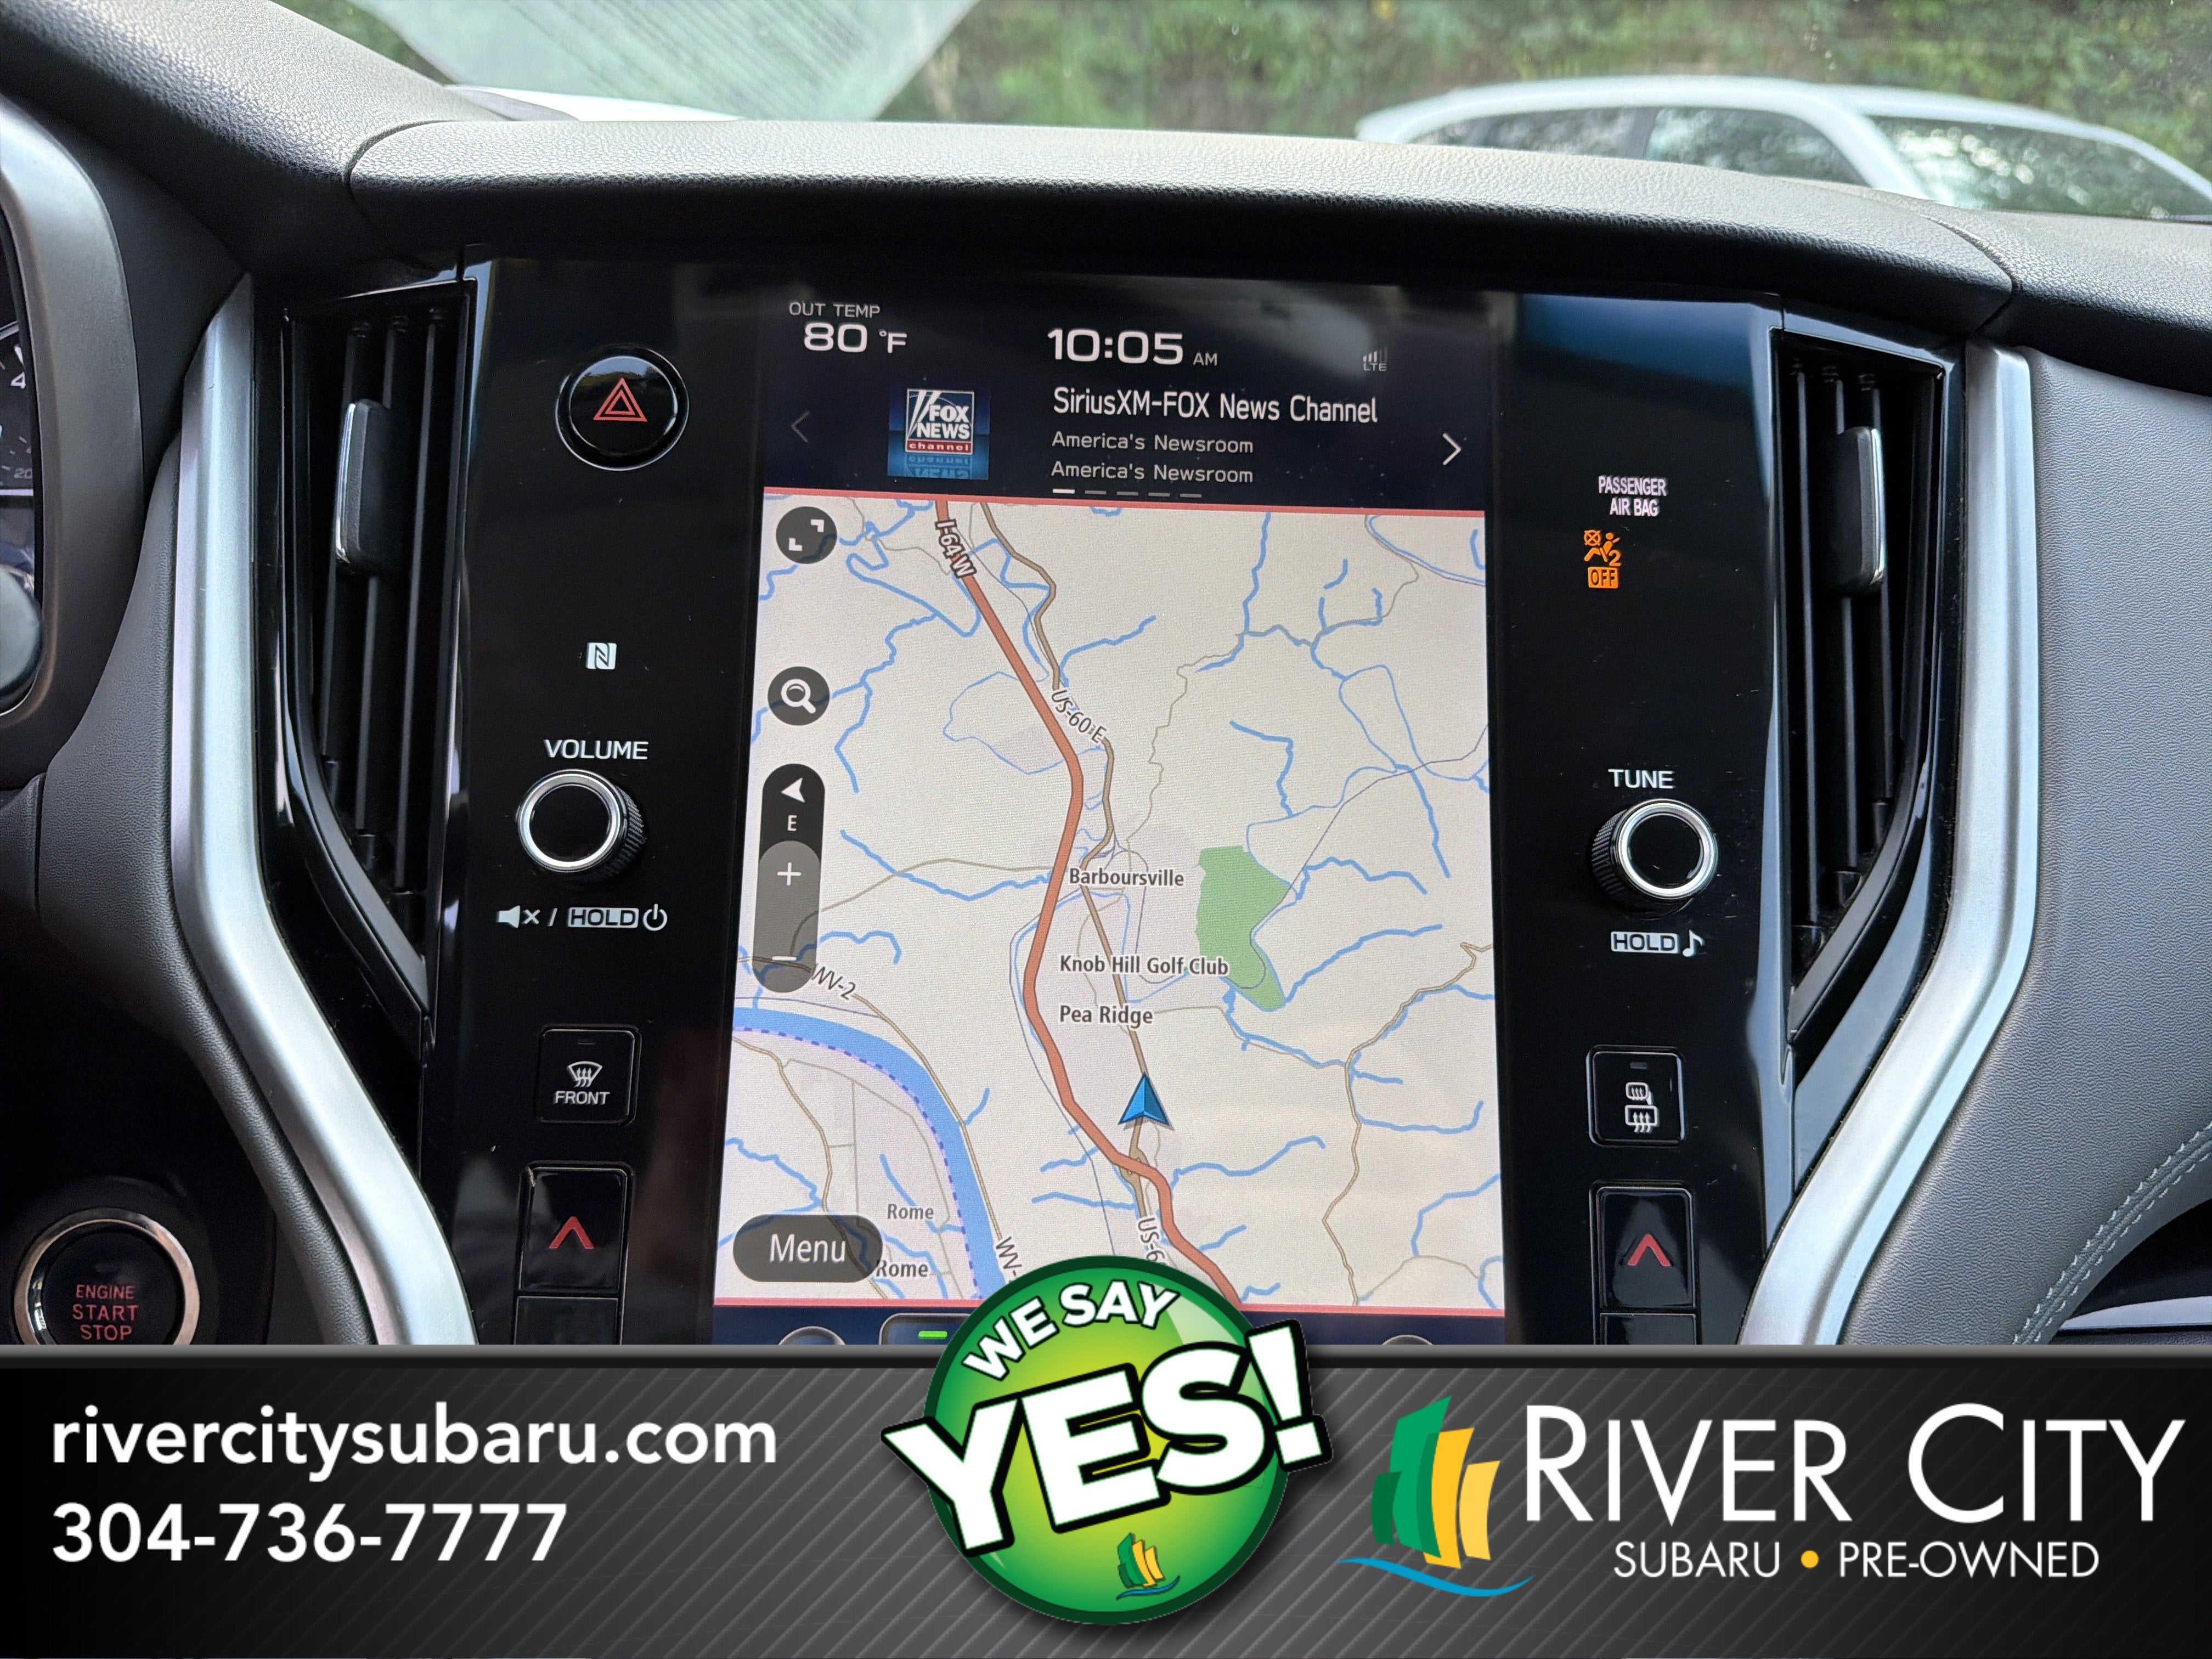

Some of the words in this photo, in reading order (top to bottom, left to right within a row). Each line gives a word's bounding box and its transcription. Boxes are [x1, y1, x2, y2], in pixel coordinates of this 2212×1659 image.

[789, 301, 826, 317] OUT
[833, 303, 881, 319] TEMP
[804, 323, 868, 353] 80
[1047, 329, 1184, 365] 10:05
[1193, 352, 1218, 366] AM
[1363, 363, 1387, 371] LTE
[929, 405, 969, 422] FOX
[1053, 387, 1210, 419] SiriusXM-FOX
[1220, 394, 1280, 421] News
[1290, 395, 1378, 424] Channel
[917, 423, 970, 439] NEWS
[909, 442, 969, 452] channel
[1052, 431, 1146, 450] America's
[1154, 435, 1254, 454] Newsroom
[1051, 461, 1146, 480] America's
[1154, 465, 1254, 483] Newsroom
[1599, 476, 1667, 496] PASSENGER
[1610, 498, 1632, 516] AIR
[1634, 499, 1660, 517] BAG
[935, 519, 964, 559] I-64
[951, 554, 977, 578] W
[1590, 569, 1616, 587] OFF
[1051, 689, 1092, 733] US-60
[1091, 725, 1107, 743] E
[545, 740, 650, 760] VOLUME
[1607, 769, 1675, 789] TUNE
[787, 815, 797, 832] E
[1069, 868, 1184, 887] Barboursville
[569, 909, 636, 927] HOLD
[1612, 933, 1677, 952] HOLD
[1060, 955, 1105, 973] Knob
[1112, 957, 1141, 974] Hill
[1147, 957, 1184, 975] Golf
[1189, 958, 1229, 975] Club
[811, 962, 856, 1001] WV-2
[1060, 1006, 1092, 1023] Pea
[1099, 1006, 1153, 1029] Ridge
[554, 1091, 610, 1105] FRONT
[887, 1203, 934, 1220] Rome
[770, 1234, 846, 1263] Menu
[1138, 1217, 1166, 1266] US-6
[995, 1235, 1023, 1282] WV-
[876, 1260, 929, 1278] Rome
[76, 1284, 135, 1300] ENGINE
[72, 1304, 139, 1322] START
[79, 1324, 132, 1341] STOP
